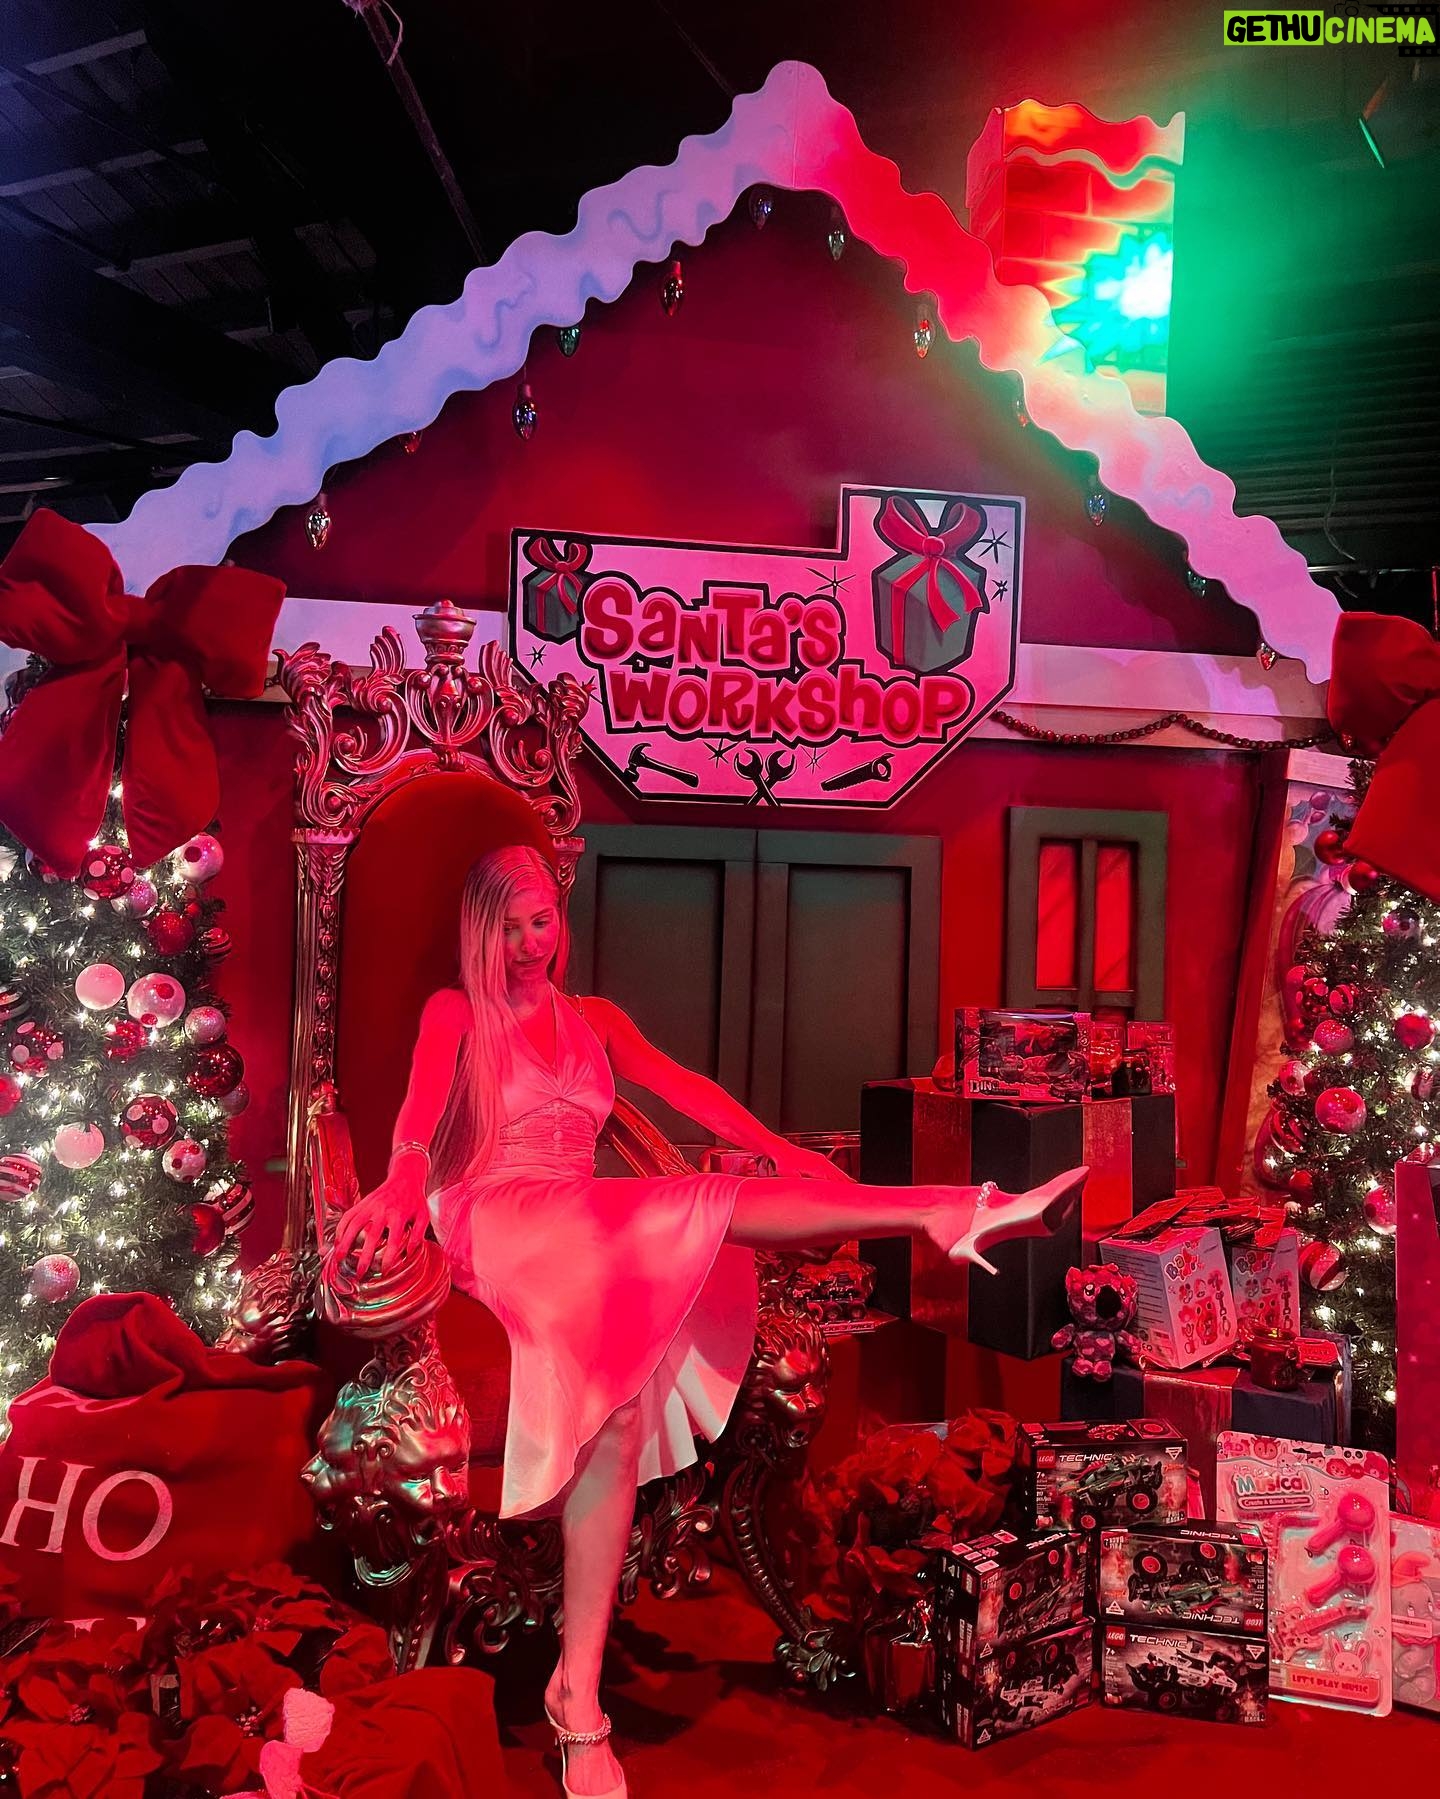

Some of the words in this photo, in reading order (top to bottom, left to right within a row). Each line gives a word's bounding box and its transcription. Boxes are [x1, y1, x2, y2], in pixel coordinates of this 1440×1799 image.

[1037, 1455, 1054, 1463] LEGO
[1058, 1453, 1113, 1462] TECHNIC
[1237, 1471, 1309, 1494] Musical
[0, 1455, 173, 1562] HO
[1180, 1529, 1238, 1541] TECHNIC
[1181, 1611, 1240, 1625] TECHNIC
[1245, 1618, 1263, 1626] LEGO
[1107, 1632, 1125, 1641] LEGO
[1129, 1634, 1188, 1649] TECHNIC
[1291, 1673, 1315, 1685] LET'S
[1316, 1677, 1341, 1689] PLAY
[1341, 1681, 1369, 1693] MUSIC
